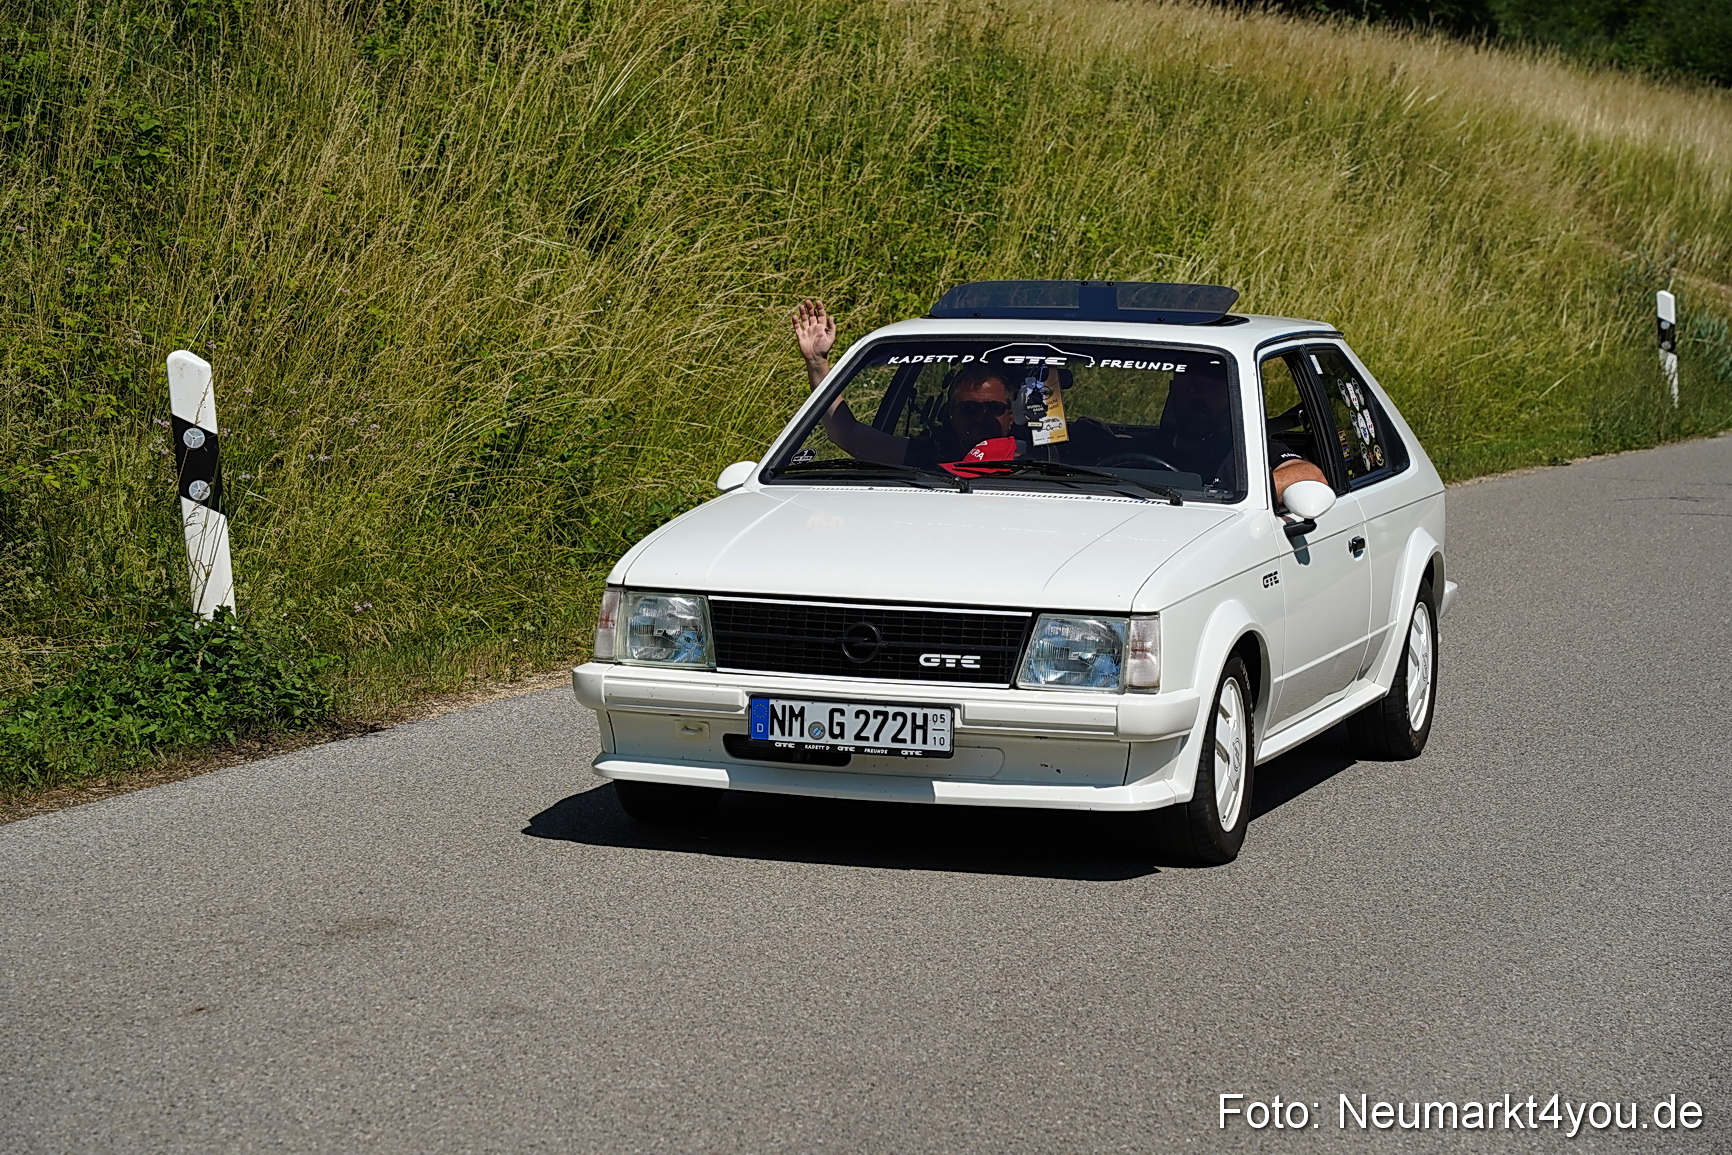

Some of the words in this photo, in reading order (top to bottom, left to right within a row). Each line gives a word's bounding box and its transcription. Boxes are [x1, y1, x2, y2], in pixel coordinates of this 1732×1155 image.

[888, 355, 958, 364] KADETT
[961, 355, 975, 363] D
[1003, 356, 1067, 365] GTE
[1100, 360, 1187, 372] FREUNDE
[1263, 571, 1279, 588] GTE
[919, 653, 981, 669] GTE
[769, 704, 805, 738] NM
[829, 708, 846, 740] G
[854, 709, 928, 745] 272H
[932, 713, 946, 724] 05
[756, 723, 764, 733] D
[933, 736, 945, 746] 10
